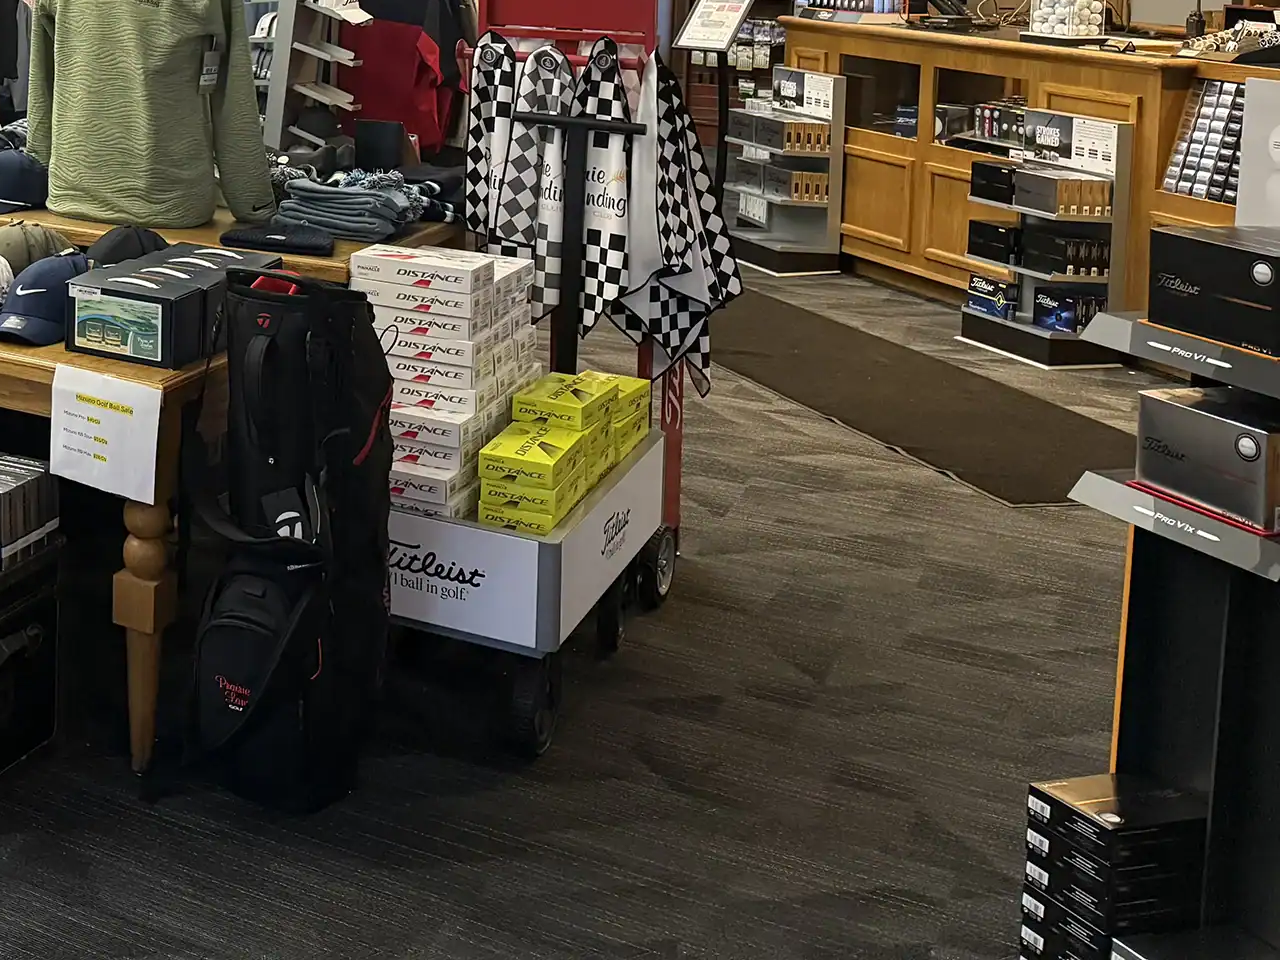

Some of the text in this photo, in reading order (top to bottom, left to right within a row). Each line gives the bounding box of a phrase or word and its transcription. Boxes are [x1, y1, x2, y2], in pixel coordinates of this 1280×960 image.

[1035, 125, 1060, 138] STROKES
[1036, 136, 1060, 148] GAINED
[1158, 272, 1201, 295] Titleist
[1171, 346, 1207, 362] PRO V1
[388, 477, 439, 494] TANCE
[1154, 512, 1176, 525] PRO
[401, 573, 423, 591] ball
[426, 579, 438, 595] in
